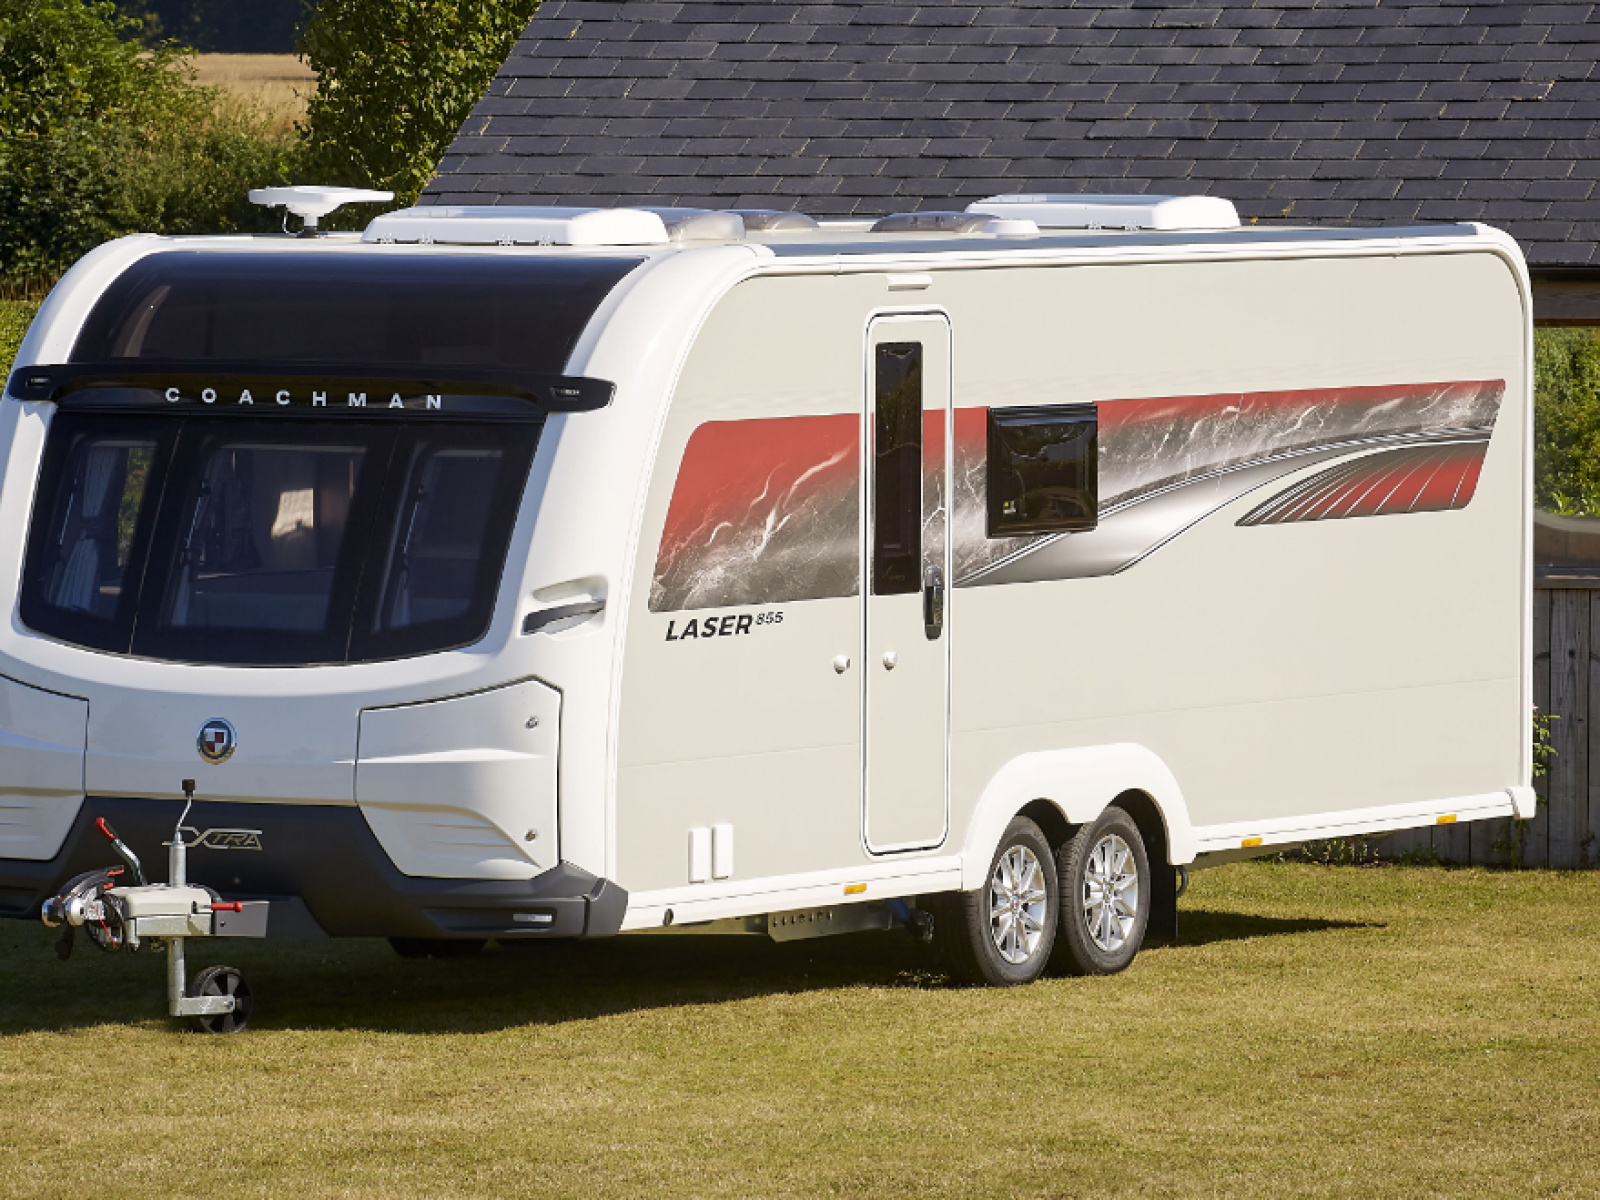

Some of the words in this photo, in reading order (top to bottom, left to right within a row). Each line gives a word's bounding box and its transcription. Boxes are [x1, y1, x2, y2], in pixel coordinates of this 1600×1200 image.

[165, 387, 441, 409] COACHMAN
[665, 614, 753, 641] LASER
[756, 611, 783, 625] 855
